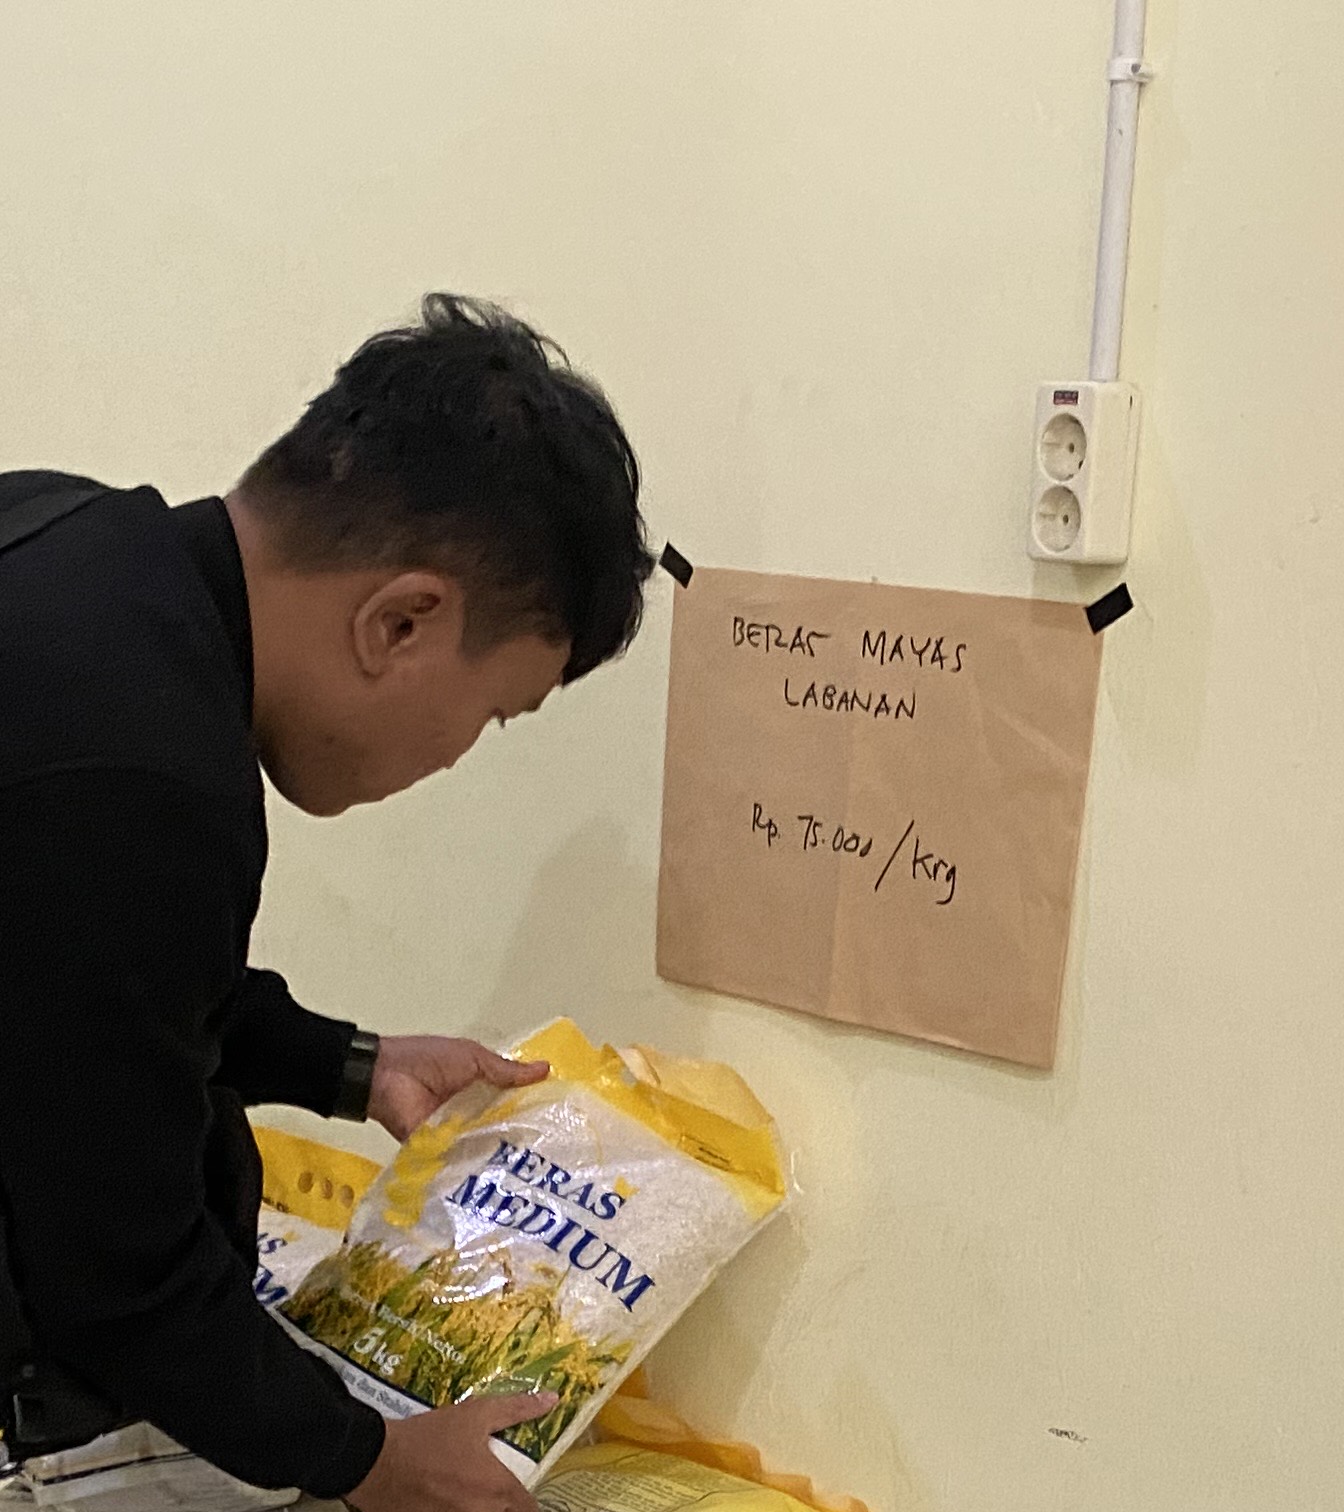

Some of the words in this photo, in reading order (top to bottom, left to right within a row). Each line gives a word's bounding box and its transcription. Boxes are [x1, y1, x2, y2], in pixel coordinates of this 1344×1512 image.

[861, 629, 967, 673] MAYAS
[783, 677, 916, 720] LABANAN
[444, 1174, 656, 1313] MEDIUM
